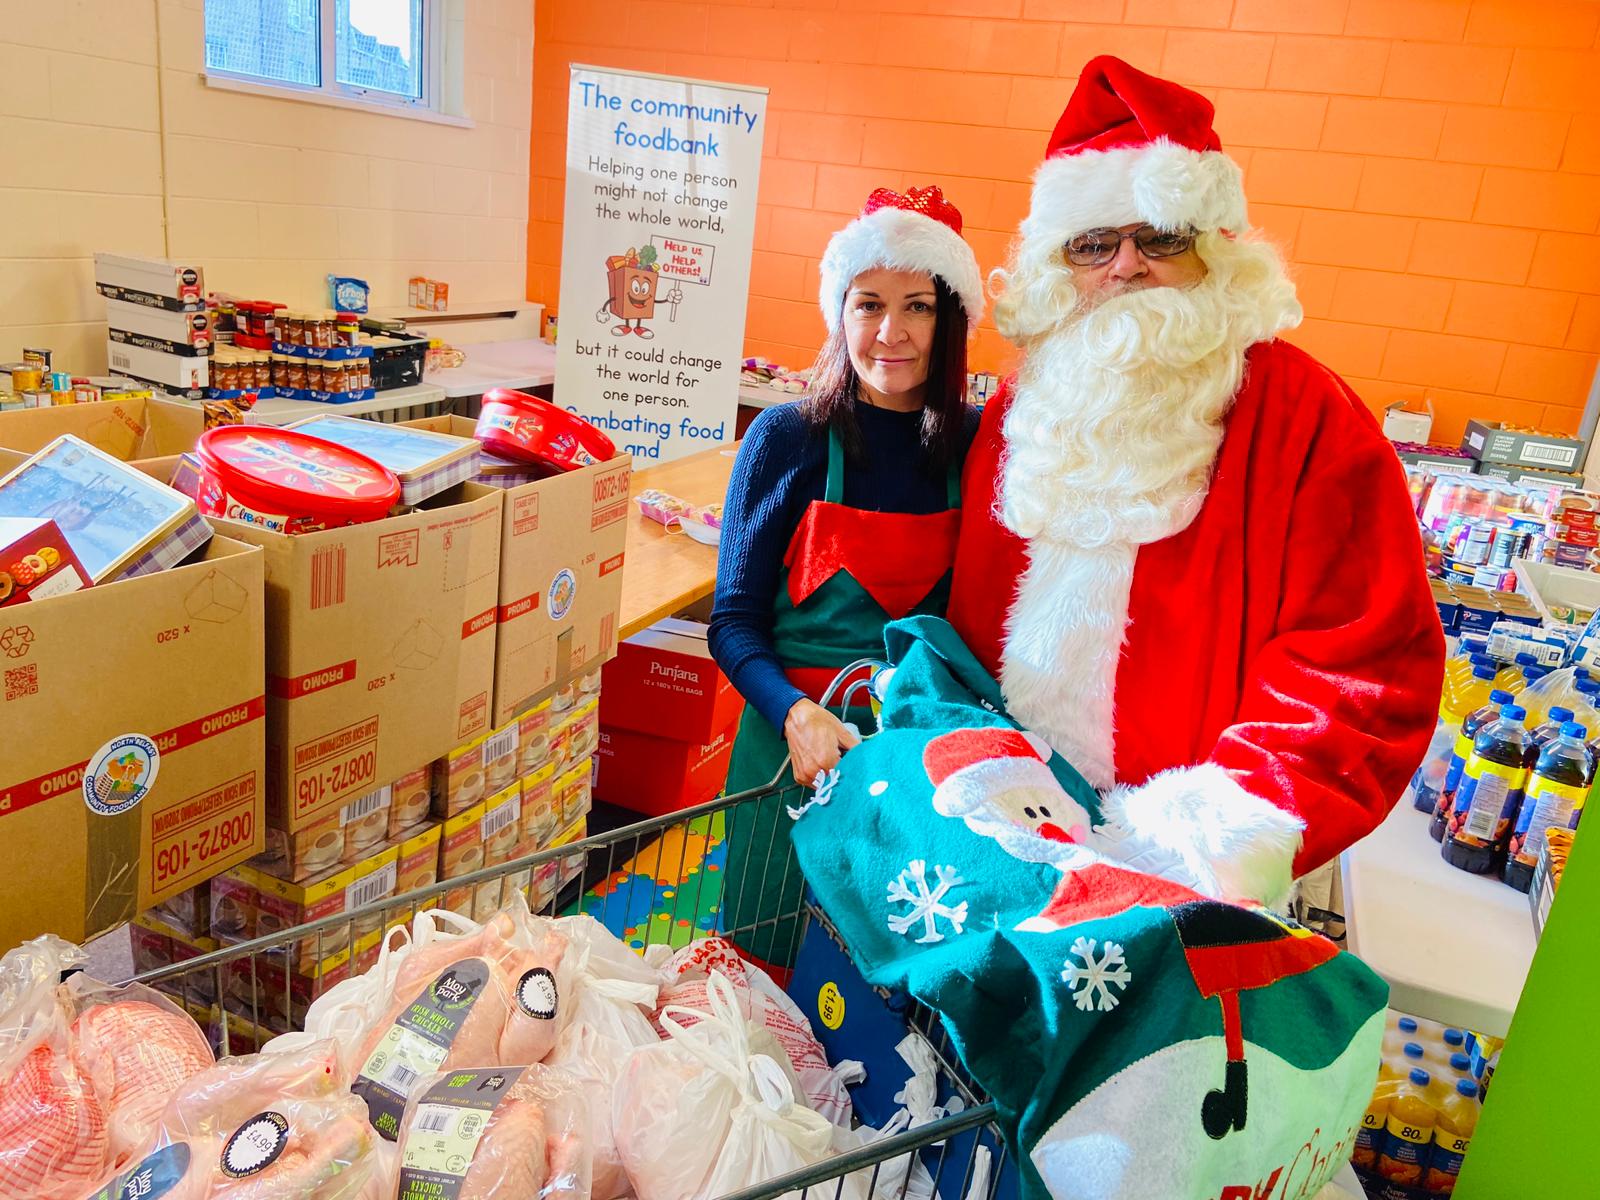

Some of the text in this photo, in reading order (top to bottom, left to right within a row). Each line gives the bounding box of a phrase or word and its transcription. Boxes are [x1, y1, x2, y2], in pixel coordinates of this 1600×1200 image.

[578, 80, 758, 133] The community
[614, 121, 719, 157] foodbank
[588, 155, 737, 189] Helping one person
[594, 184, 728, 212] might not change
[596, 203, 725, 234] the whole world,
[576, 340, 722, 372] but it could change
[597, 364, 699, 388] the world for
[603, 390, 690, 408] one person.
[679, 418, 724, 440] food
[624, 440, 660, 459] and
[507, 598, 531, 617] PROMO
[471, 613, 494, 631] PROMO
[157, 628, 180, 644] 520
[302, 670, 344, 691] PROMO
[367, 675, 386, 691] 520
[650, 661, 699, 683] Punjana
[672, 685, 685, 693] TEA
[686, 687, 703, 696] BAGS
[201, 706, 249, 735] PROMO
[299, 751, 374, 809] 00872-105
[157, 811, 252, 881] 00872-105
[436, 987, 461, 1003] park
[443, 977, 467, 995] Moy
[823, 987, 837, 1020] £1.99
[410, 1005, 456, 1030] IRISH WHOLE
[411, 1014, 444, 1034] CHICKEN
[246, 1130, 273, 1153] £4.99
[1453, 1140, 1471, 1152] 80
[125, 1177, 140, 1200] par
[140, 1168, 153, 1195] Moy
[411, 1180, 443, 1195] CHICKEN
